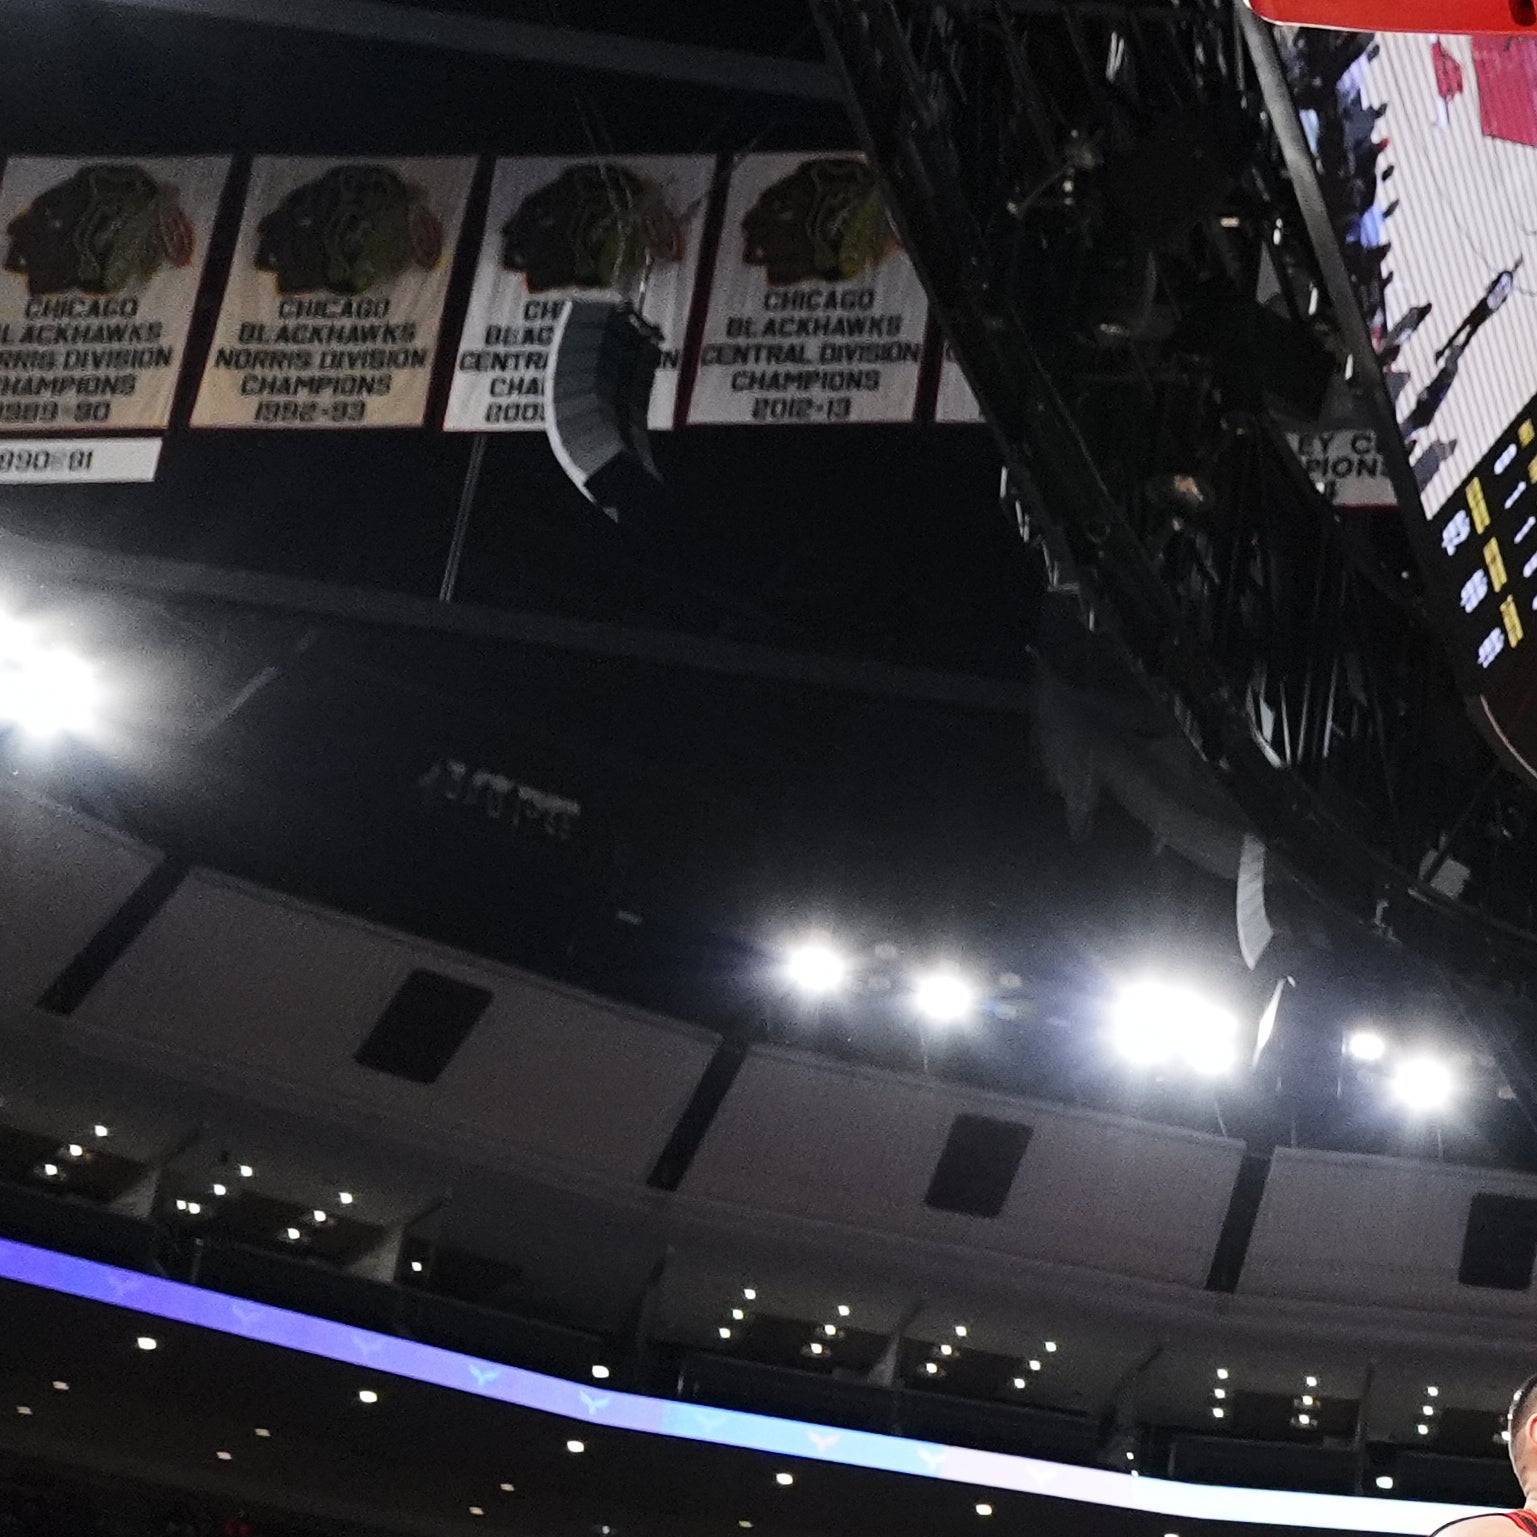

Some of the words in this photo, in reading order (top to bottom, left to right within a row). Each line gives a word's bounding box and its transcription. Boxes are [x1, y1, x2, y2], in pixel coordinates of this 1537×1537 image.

[764, 289, 874, 311] CHICAGO
[0, 321, 163, 343] LACKHAWKS
[726, 315, 902, 338] BLACKHAWKS
[0, 374, 136, 396] HAMPIONS
